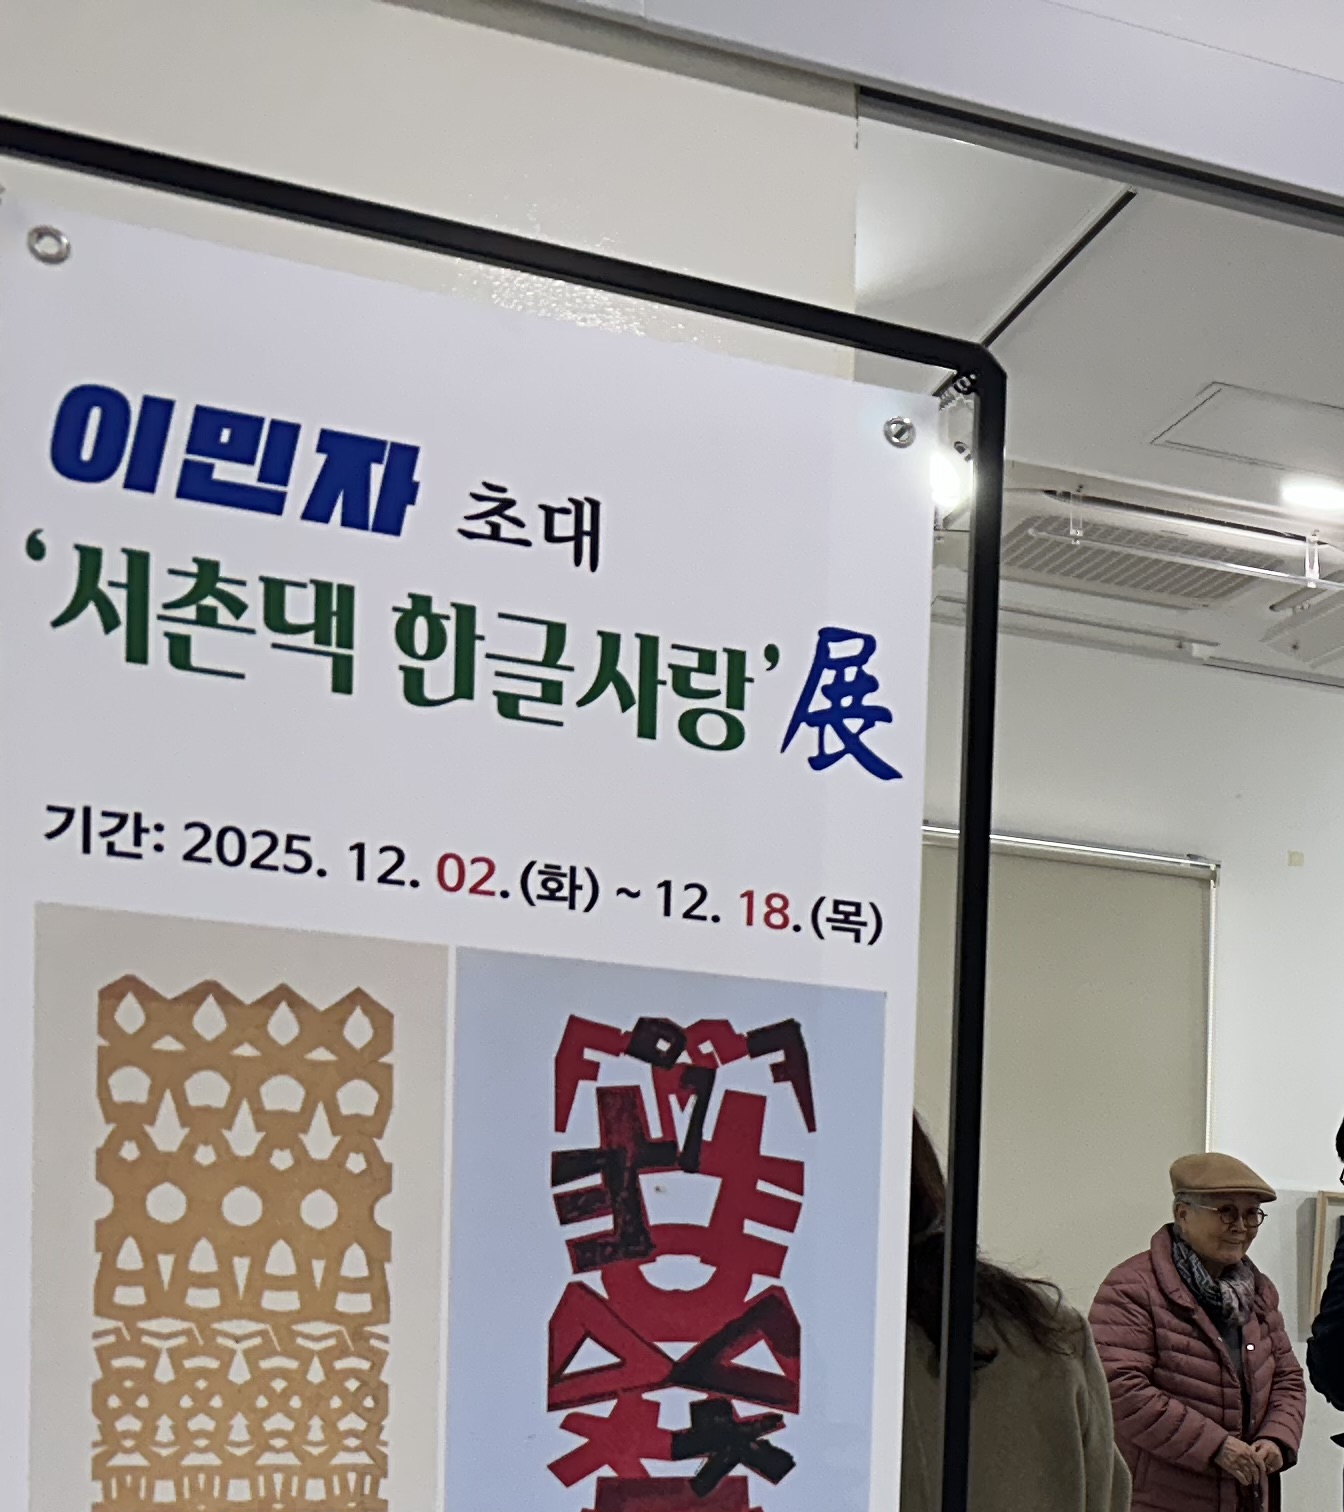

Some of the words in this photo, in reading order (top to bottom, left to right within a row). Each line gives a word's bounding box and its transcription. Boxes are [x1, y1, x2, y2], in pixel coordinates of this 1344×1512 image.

[50, 384, 420, 537] 이민자
[457, 481, 601, 573] 초대
[25, 528, 355, 695] ‘서촌댁
[44, 805, 165, 860] 기간:
[182, 821, 327, 878] 2025.
[349, 842, 420, 888] 12.
